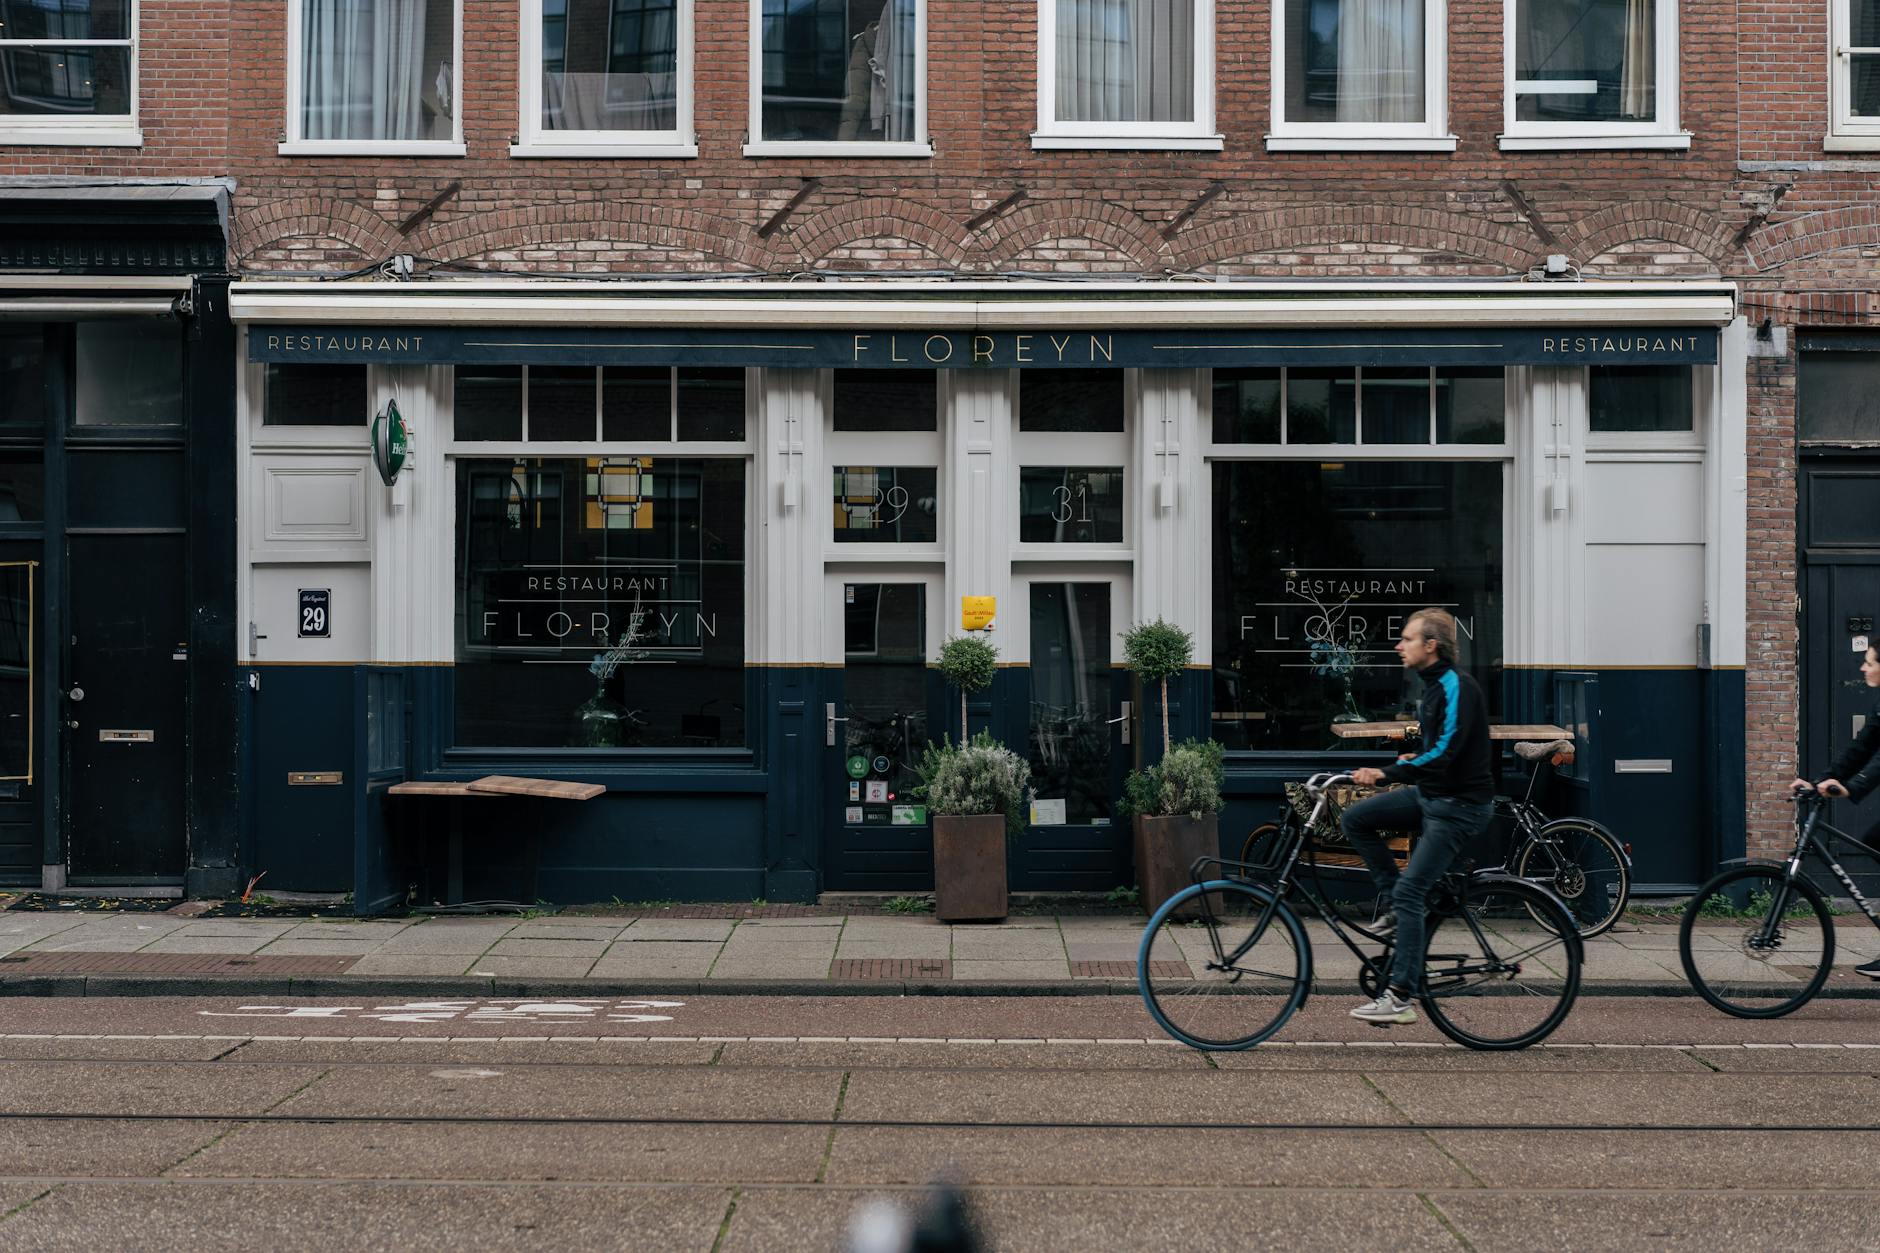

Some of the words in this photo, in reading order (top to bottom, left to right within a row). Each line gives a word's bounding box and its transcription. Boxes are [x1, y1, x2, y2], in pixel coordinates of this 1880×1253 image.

[268, 335, 423, 351] RESTAURANT
[854, 334, 1112, 363] FLOREYN
[1543, 337, 1698, 353] RESTAURANT
[1051, 485, 1092, 523] 31
[528, 577, 669, 591] RESTAURANT
[1285, 580, 1426, 594] RESTAURANT
[303, 607, 325, 631] 29
[483, 611, 717, 638] FLOREYN
[1241, 615, 1474, 641] FLOREN
